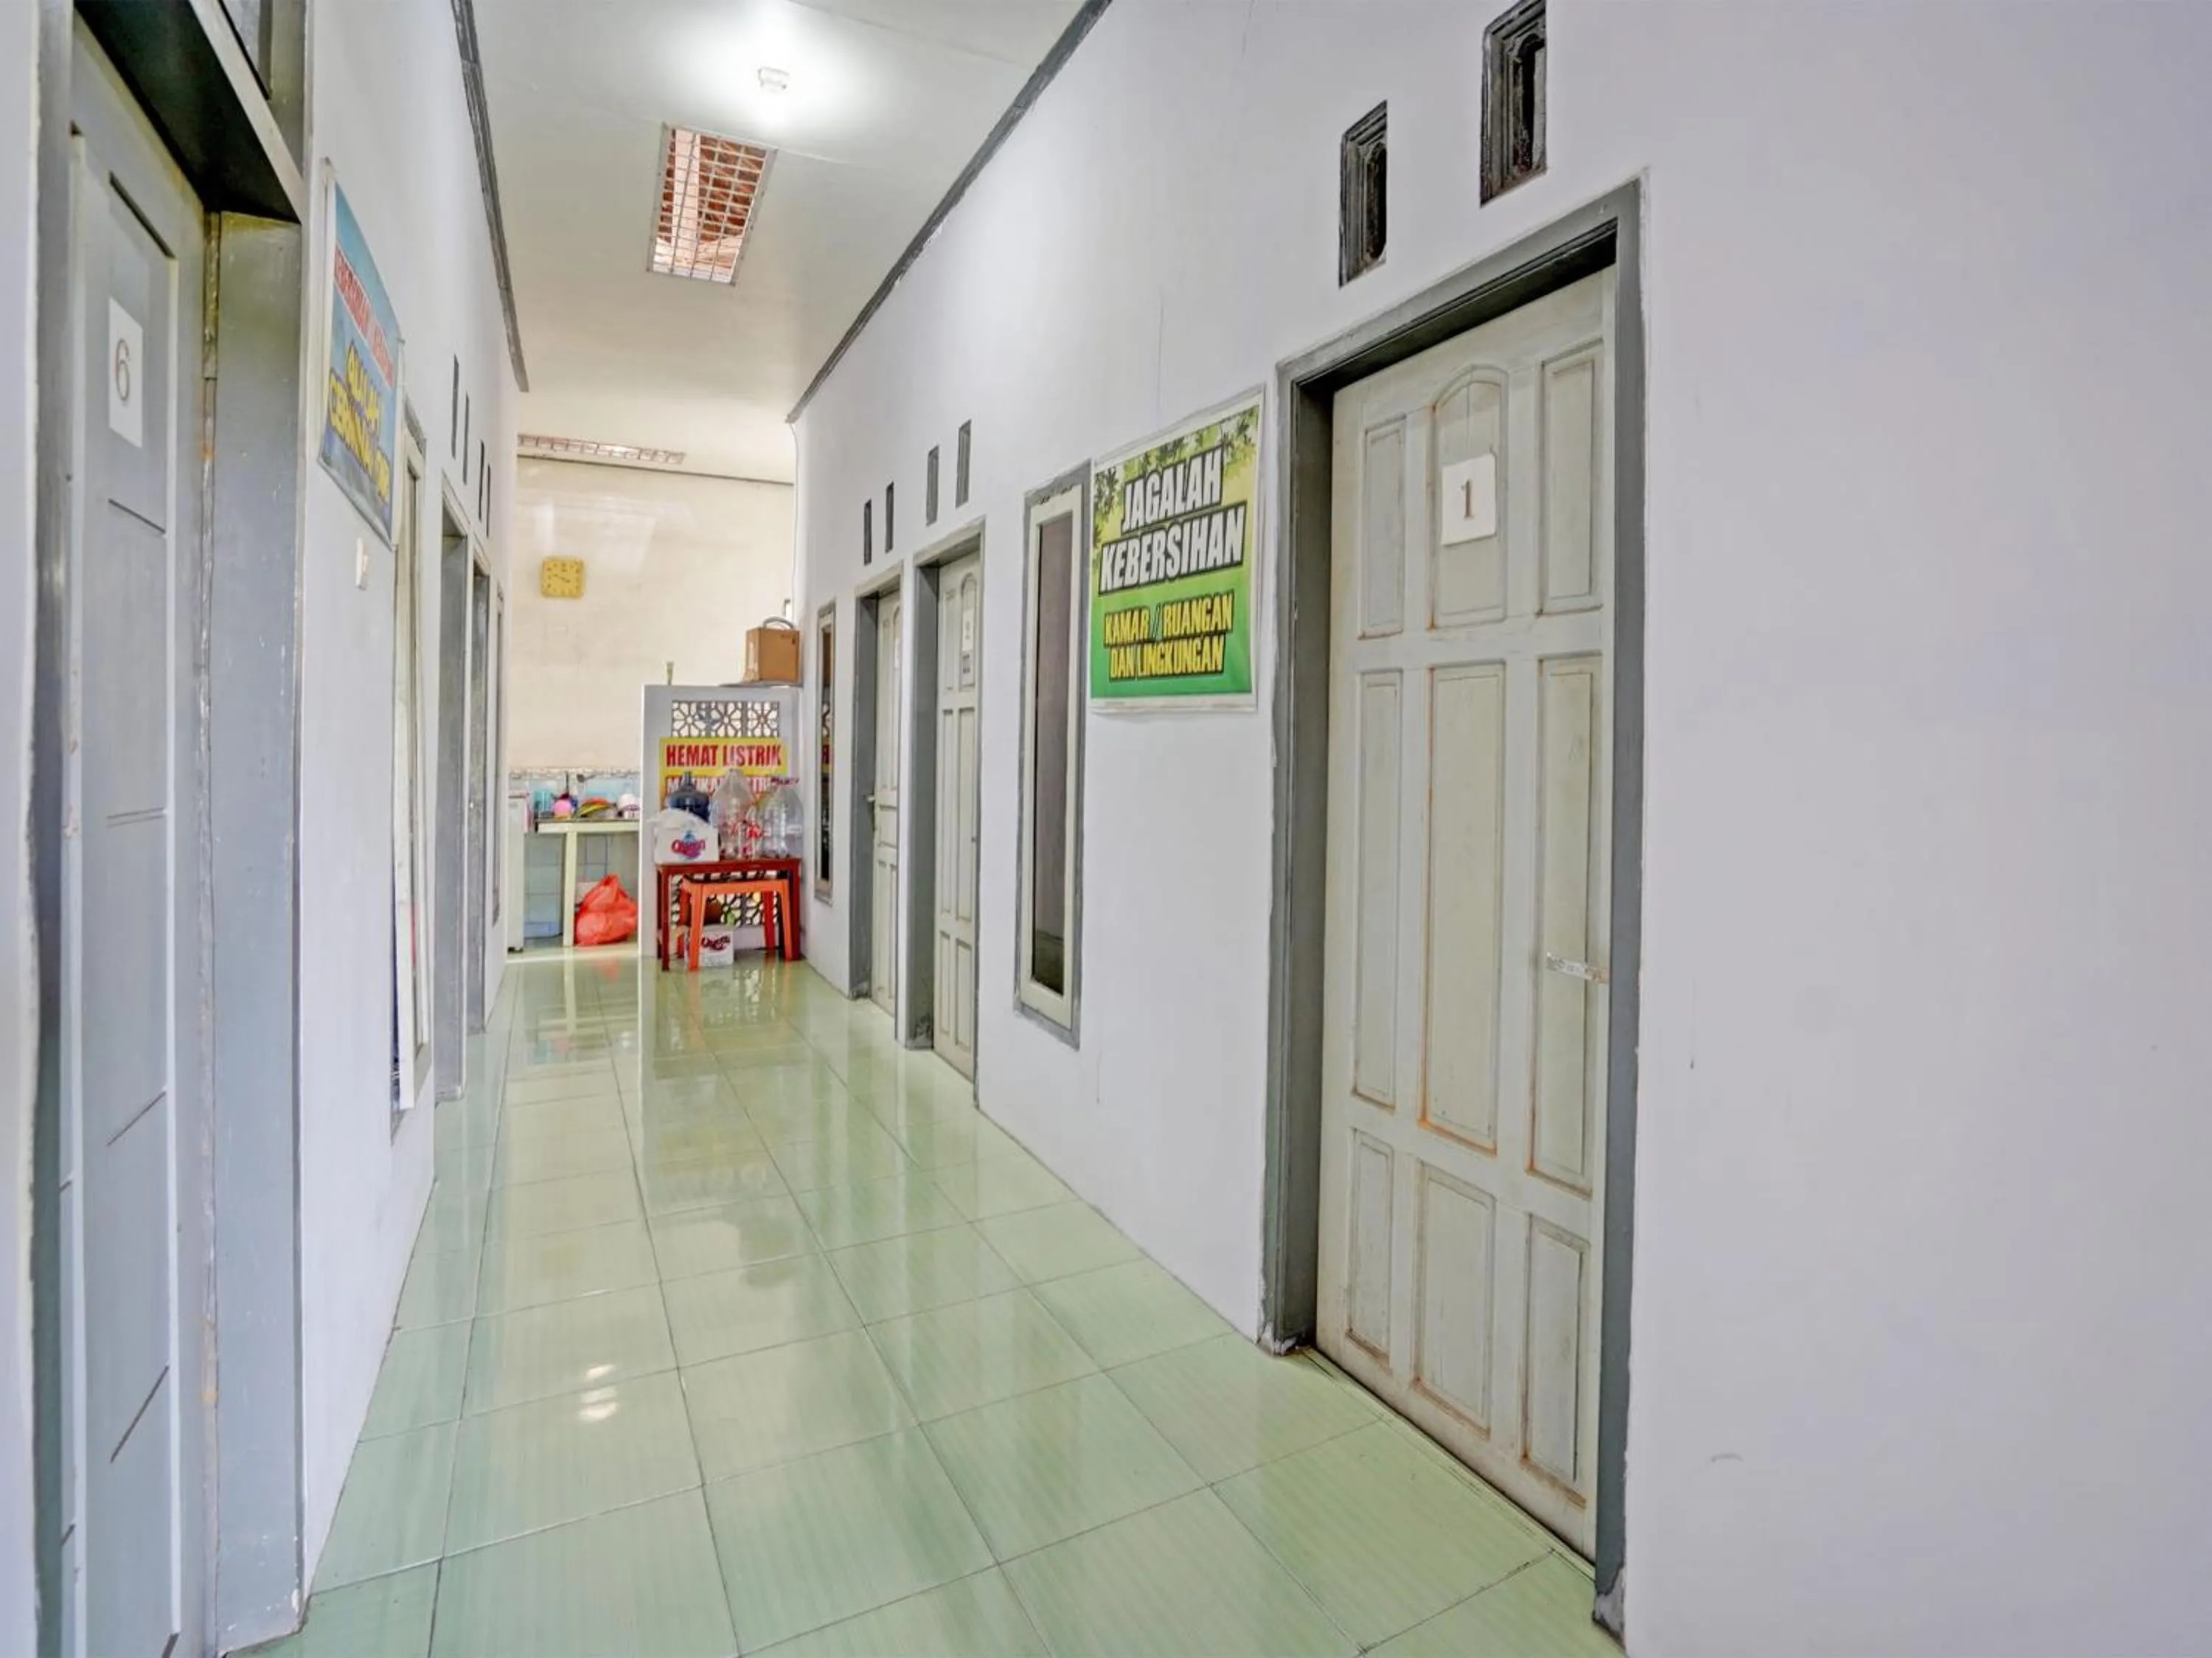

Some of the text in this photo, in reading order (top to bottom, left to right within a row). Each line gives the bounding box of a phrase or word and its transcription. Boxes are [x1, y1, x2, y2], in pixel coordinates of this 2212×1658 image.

[116, 337, 131, 403] 6
[1121, 446, 1223, 534] JAGALAH
[1461, 479, 1475, 521] 1
[1099, 503, 1246, 594] KEBERSIHAN
[1105, 607, 1150, 645] KAMAR
[1163, 592, 1234, 639] RUANGAN
[1110, 636, 1225, 681] DAN LINGKUNGAN
[666, 744, 781, 767] HEMAT LISTRIK
